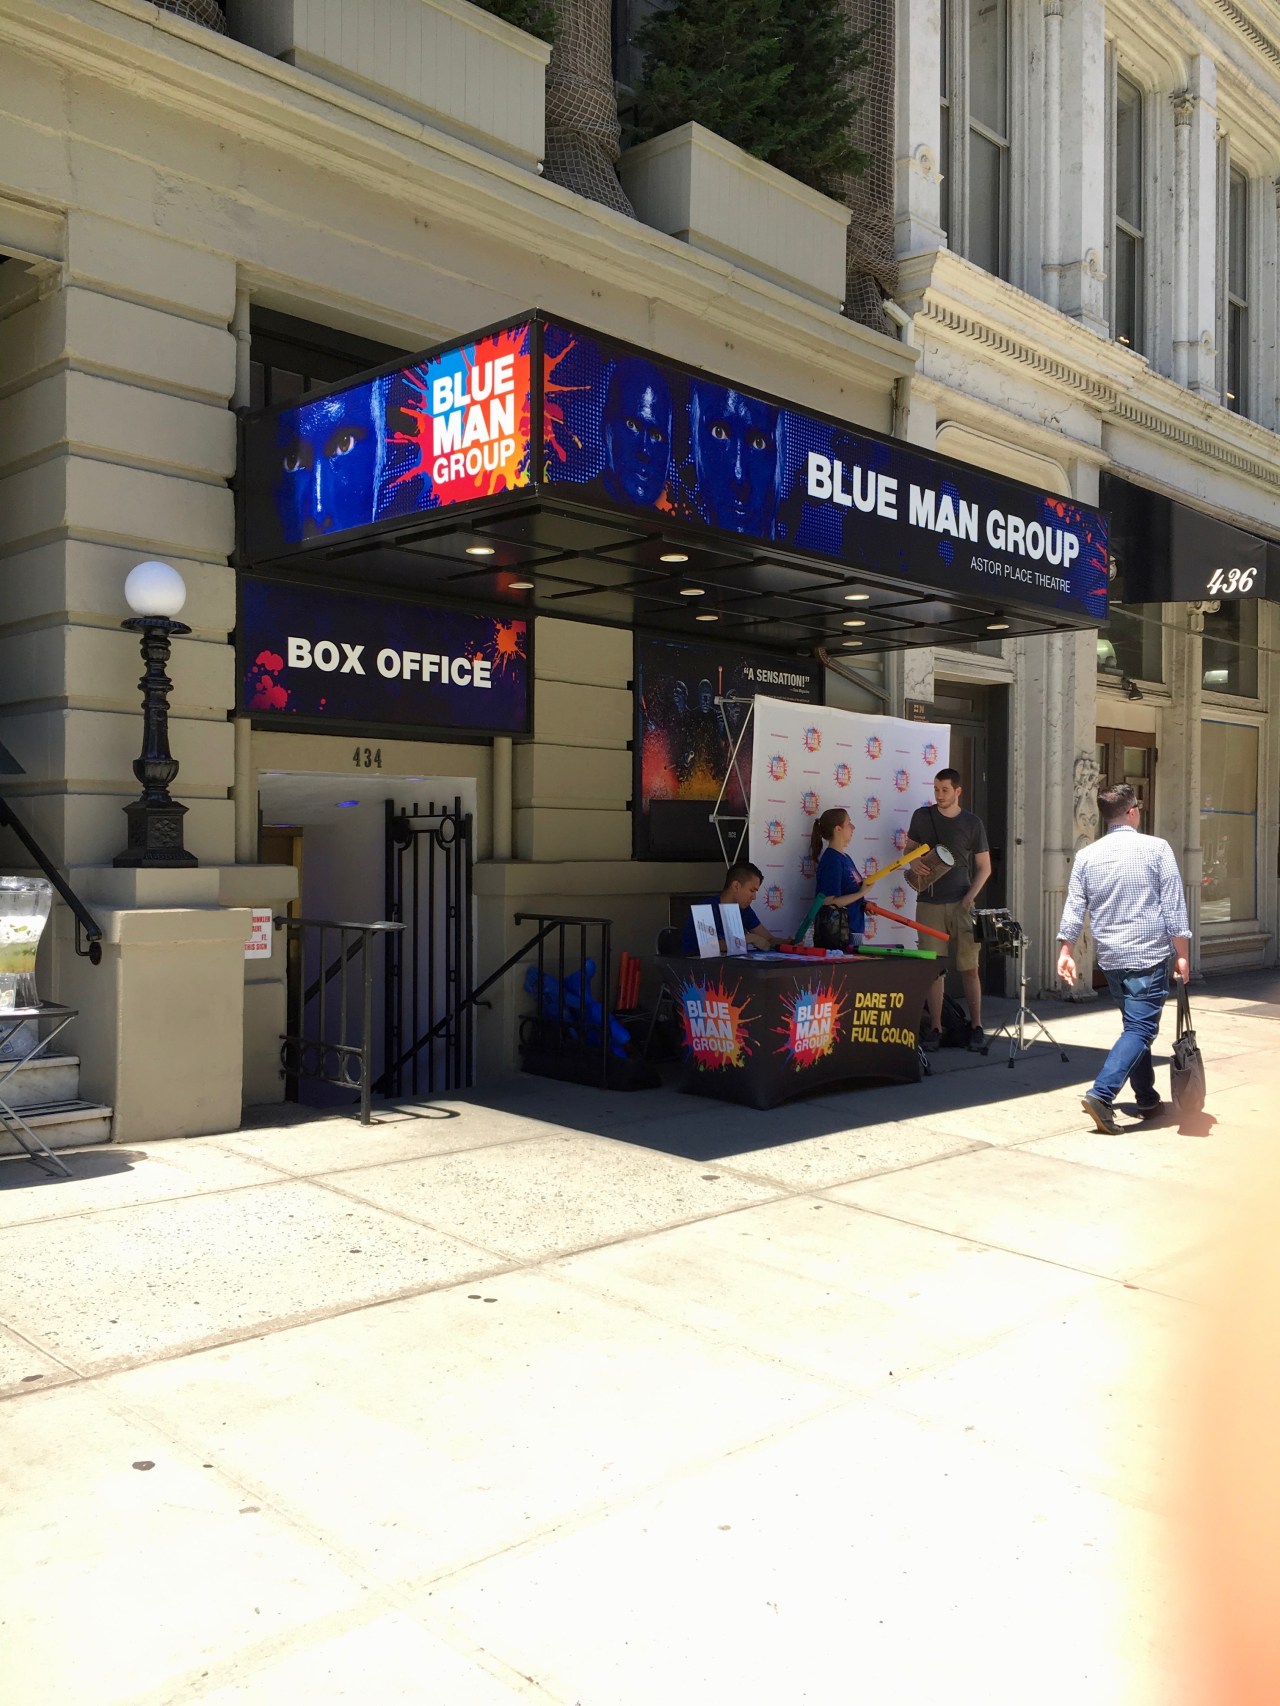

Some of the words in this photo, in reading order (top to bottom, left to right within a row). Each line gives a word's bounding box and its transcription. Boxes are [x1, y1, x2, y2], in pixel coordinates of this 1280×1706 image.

[433, 353, 515, 415] BLUE
[433, 393, 515, 457] MAN
[433, 438, 516, 484] GROUP
[807, 451, 898, 520] BLUE
[909, 483, 979, 543] MAN
[986, 509, 1080, 568] GROUP
[970, 556, 1002, 577] ASTOR
[1004, 567, 1033, 585] PLACE
[1034, 573, 1071, 594] THEATRE
[1206, 567, 1258, 595] 436
[287, 636, 366, 676] BOX
[376, 648, 492, 689] OFFICE
[352, 747, 383, 768] 434
[687, 1000, 730, 1020] BLUE
[797, 1002, 832, 1022] BLUE
[855, 992, 886, 1009] DARE
[889, 992, 905, 1009] TO
[690, 1018, 733, 1040] MAN
[796, 1018, 831, 1041] MAN
[853, 1010, 878, 1026] LIVE
[879, 1012, 891, 1026] IN
[692, 1038, 735, 1053] GROUP
[794, 1035, 829, 1053] GROUP
[851, 1027, 879, 1043] FULL
[881, 1027, 915, 1050] COLOR
